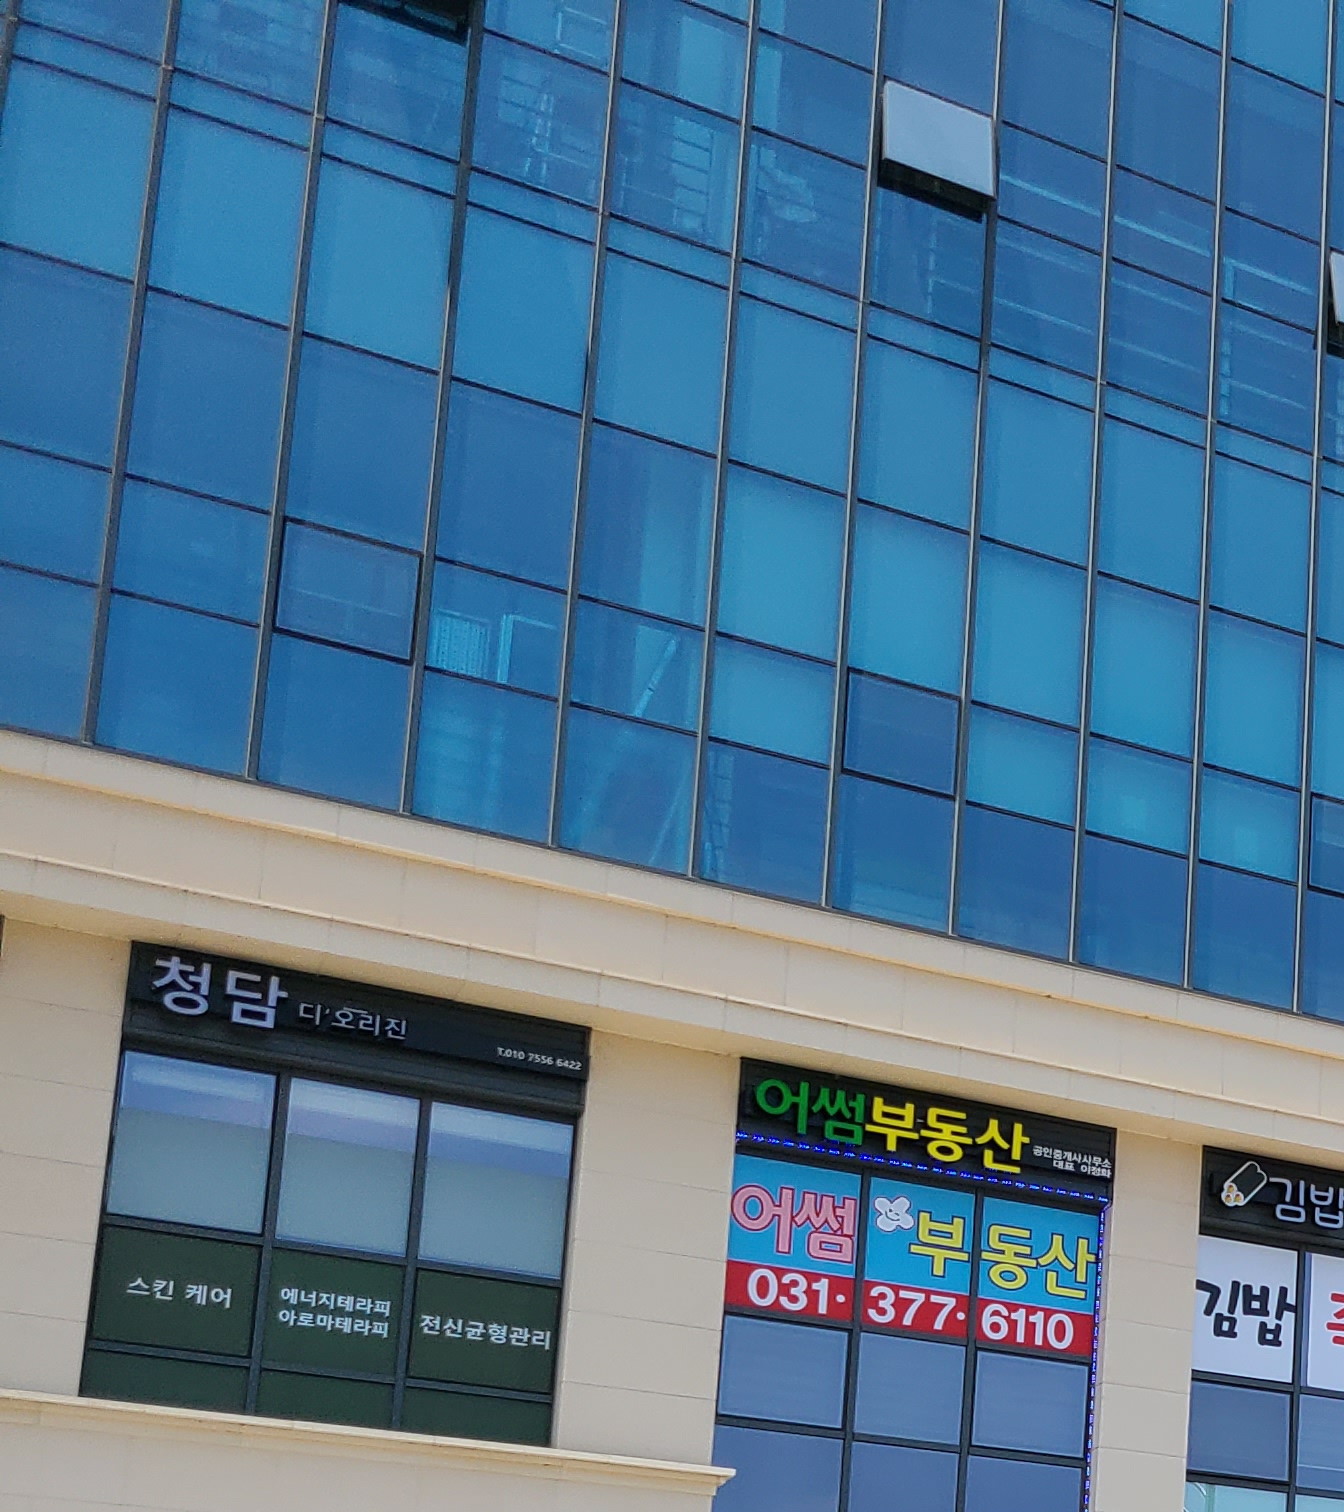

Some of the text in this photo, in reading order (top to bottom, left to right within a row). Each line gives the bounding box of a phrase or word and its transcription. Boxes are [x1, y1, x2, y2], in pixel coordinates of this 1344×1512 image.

[152, 956, 288, 1029] 청담
[528, 1053, 553, 1066] 7556
[556, 1058, 582, 1071] 6422
[730, 1184, 1096, 1300] 어썸 부동산
[126, 1277, 232, 1308] 스킨 케어
[281, 1286, 391, 1317] 에너지테라피
[278, 1309, 389, 1339] 아로마테라피
[981, 1302, 1074, 1351] 6110
[1195, 1279, 1297, 1347] 김밥
[420, 1314, 550, 1350] 전신균형관리
